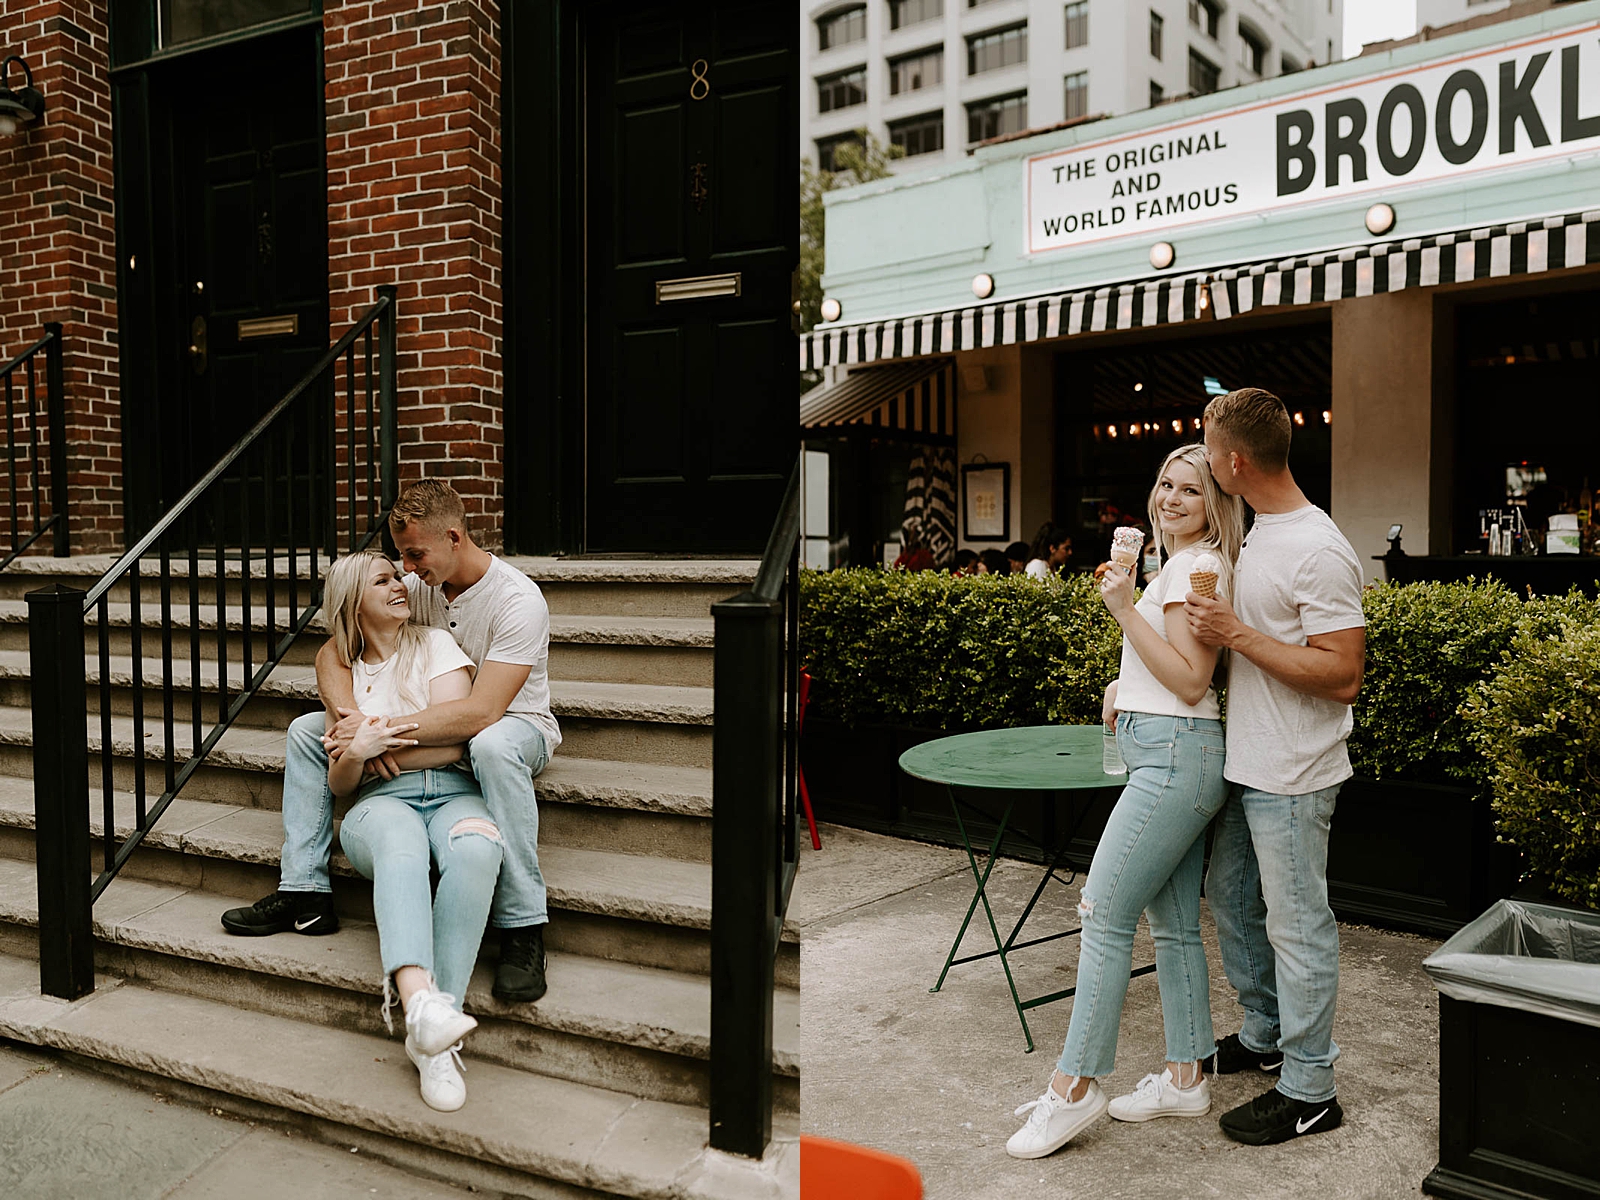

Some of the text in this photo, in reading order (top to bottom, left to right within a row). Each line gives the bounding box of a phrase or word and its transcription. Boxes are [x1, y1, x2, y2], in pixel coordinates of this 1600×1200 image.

[690, 59, 709, 100] 8
[1276, 42, 1600, 197] BROOKL
[1053, 131, 1227, 184] THE ORIGINAL
[1043, 183, 1239, 237] WORLD FAMOUS
[1111, 172, 1161, 199] AND
